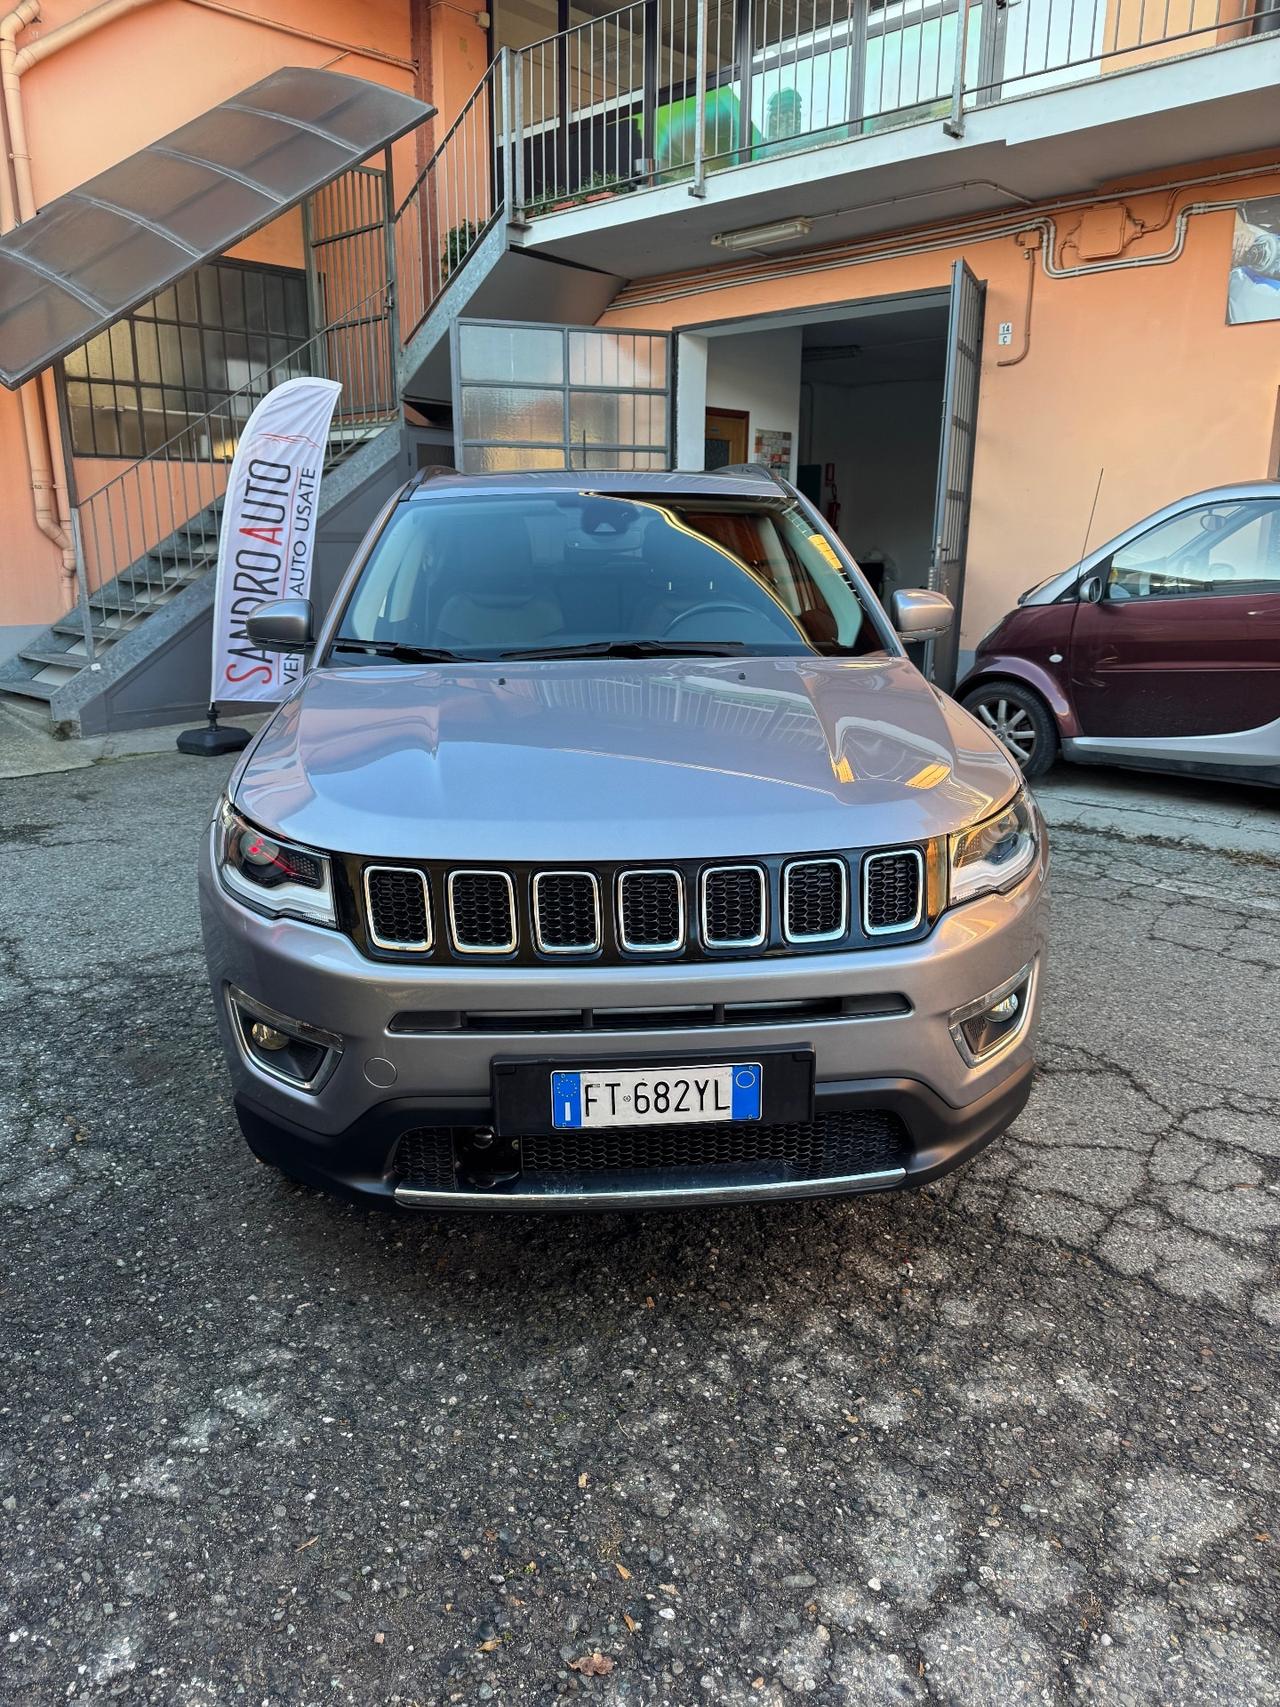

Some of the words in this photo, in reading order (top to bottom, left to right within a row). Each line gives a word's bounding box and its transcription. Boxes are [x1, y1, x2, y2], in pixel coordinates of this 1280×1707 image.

[1001, 324, 1010, 333] 14
[238, 458, 291, 546] AUTO
[294, 467, 316, 532] USATE
[289, 540, 308, 597] AUTO
